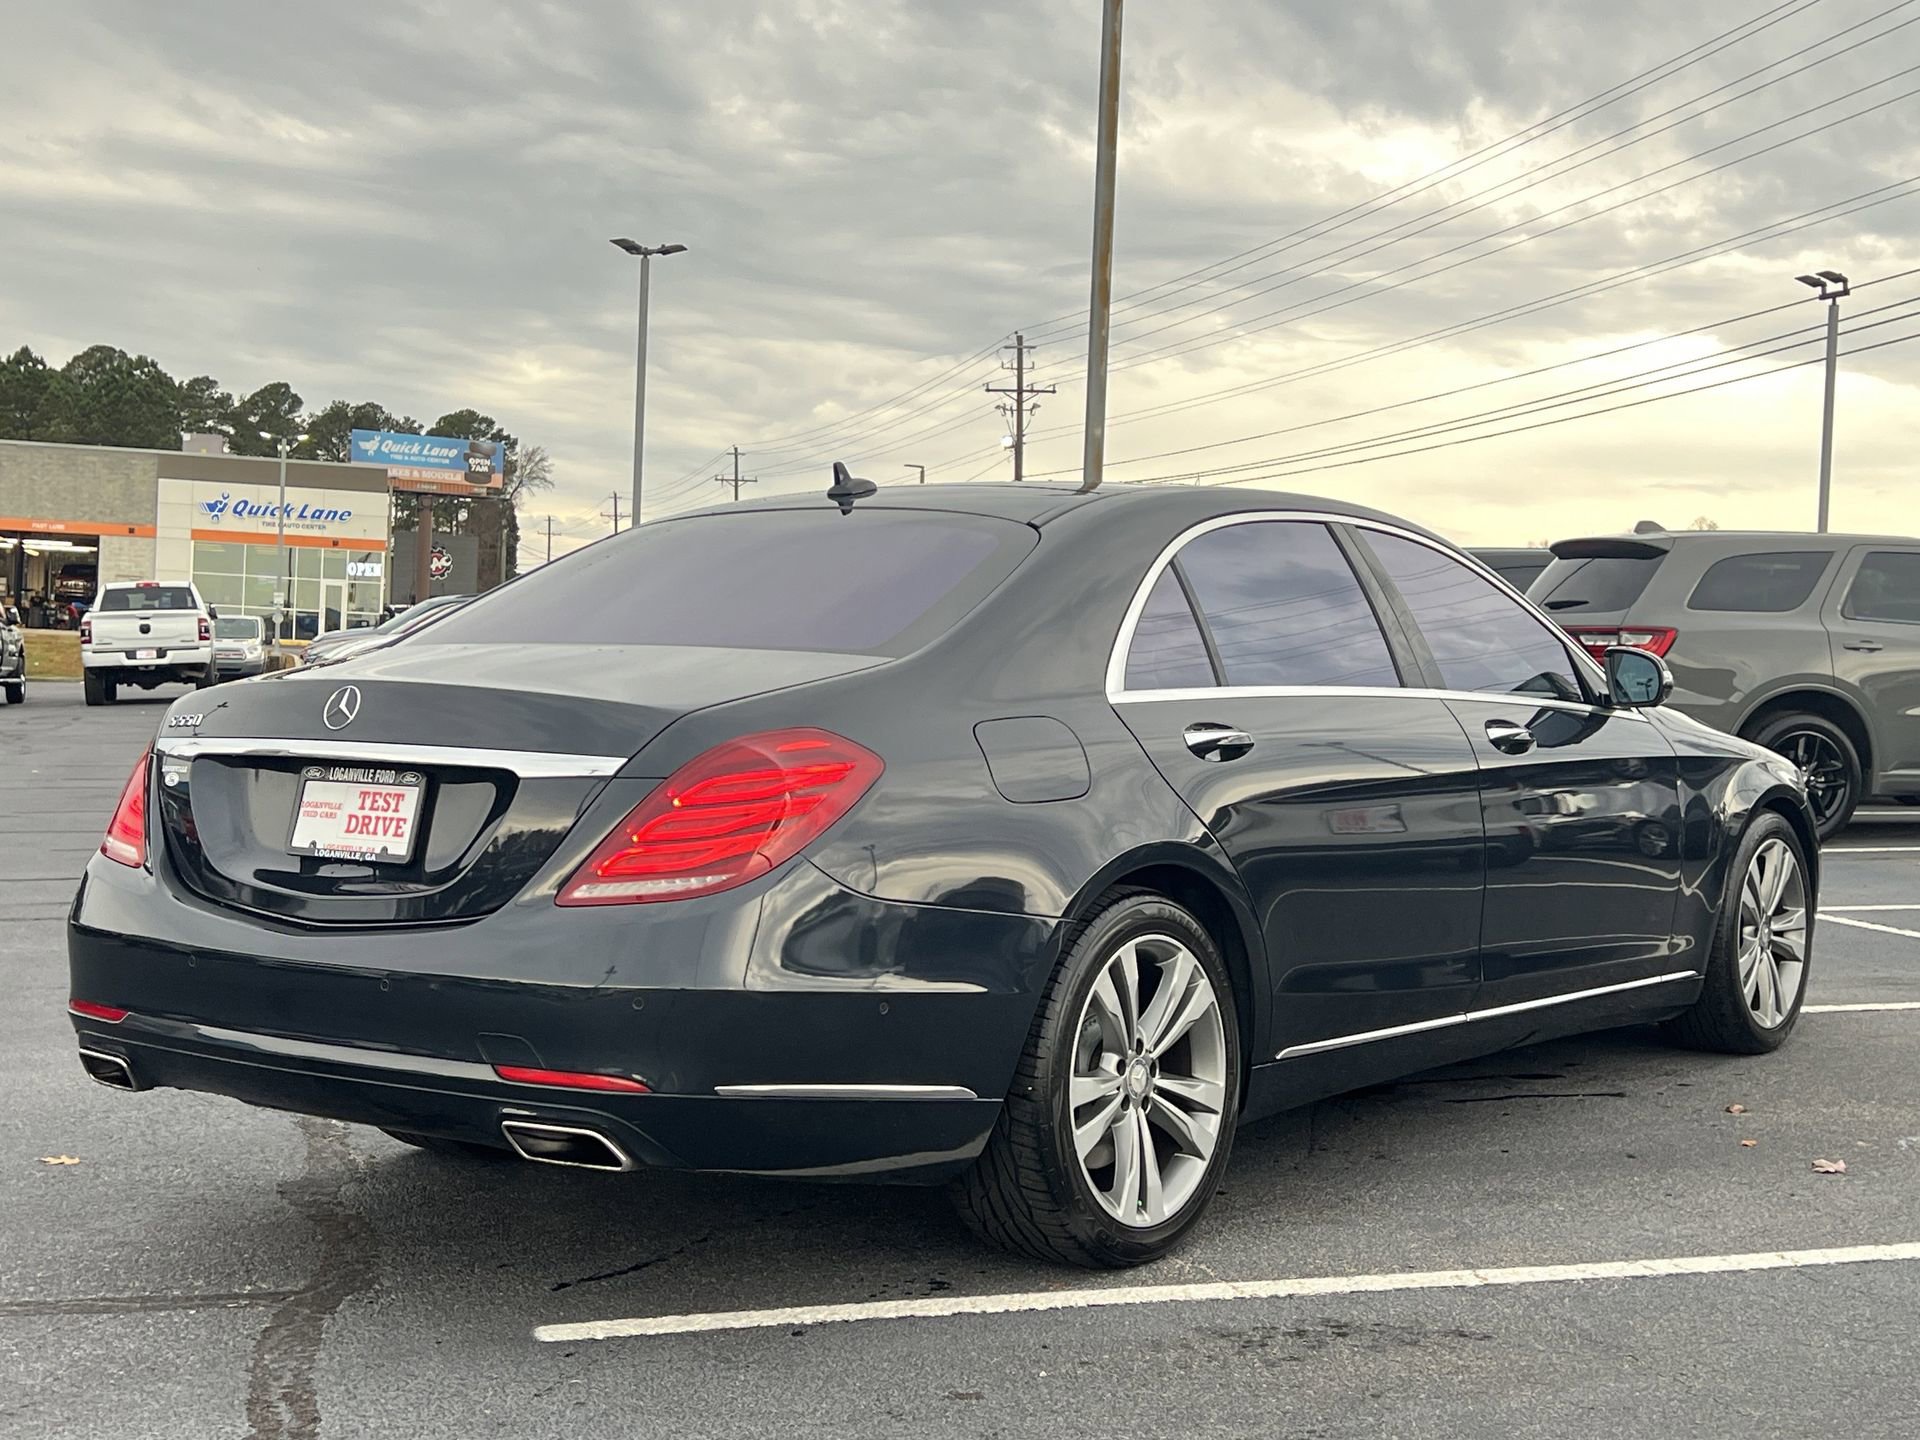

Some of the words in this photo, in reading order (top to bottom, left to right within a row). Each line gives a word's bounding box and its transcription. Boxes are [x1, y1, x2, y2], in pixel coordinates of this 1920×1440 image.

[381, 439, 421, 455] Quick
[422, 443, 458, 458] Lane
[468, 457, 491, 466] OPEN
[470, 463, 489, 473] 7AM
[422, 470, 461, 481] MODELS
[232, 499, 295, 519] Quick
[297, 503, 352, 522] Lane
[347, 562, 382, 577] OPEN
[169, 713, 204, 728] S550
[329, 767, 374, 781] LOGANVILLE
[374, 769, 396, 784] FORD
[301, 800, 343, 811] LOGANVILLE
[358, 790, 405, 813] TEST
[303, 810, 318, 818] USED
[320, 811, 338, 819] CARS
[344, 814, 407, 838] DRIVE
[364, 852, 376, 861] GA
